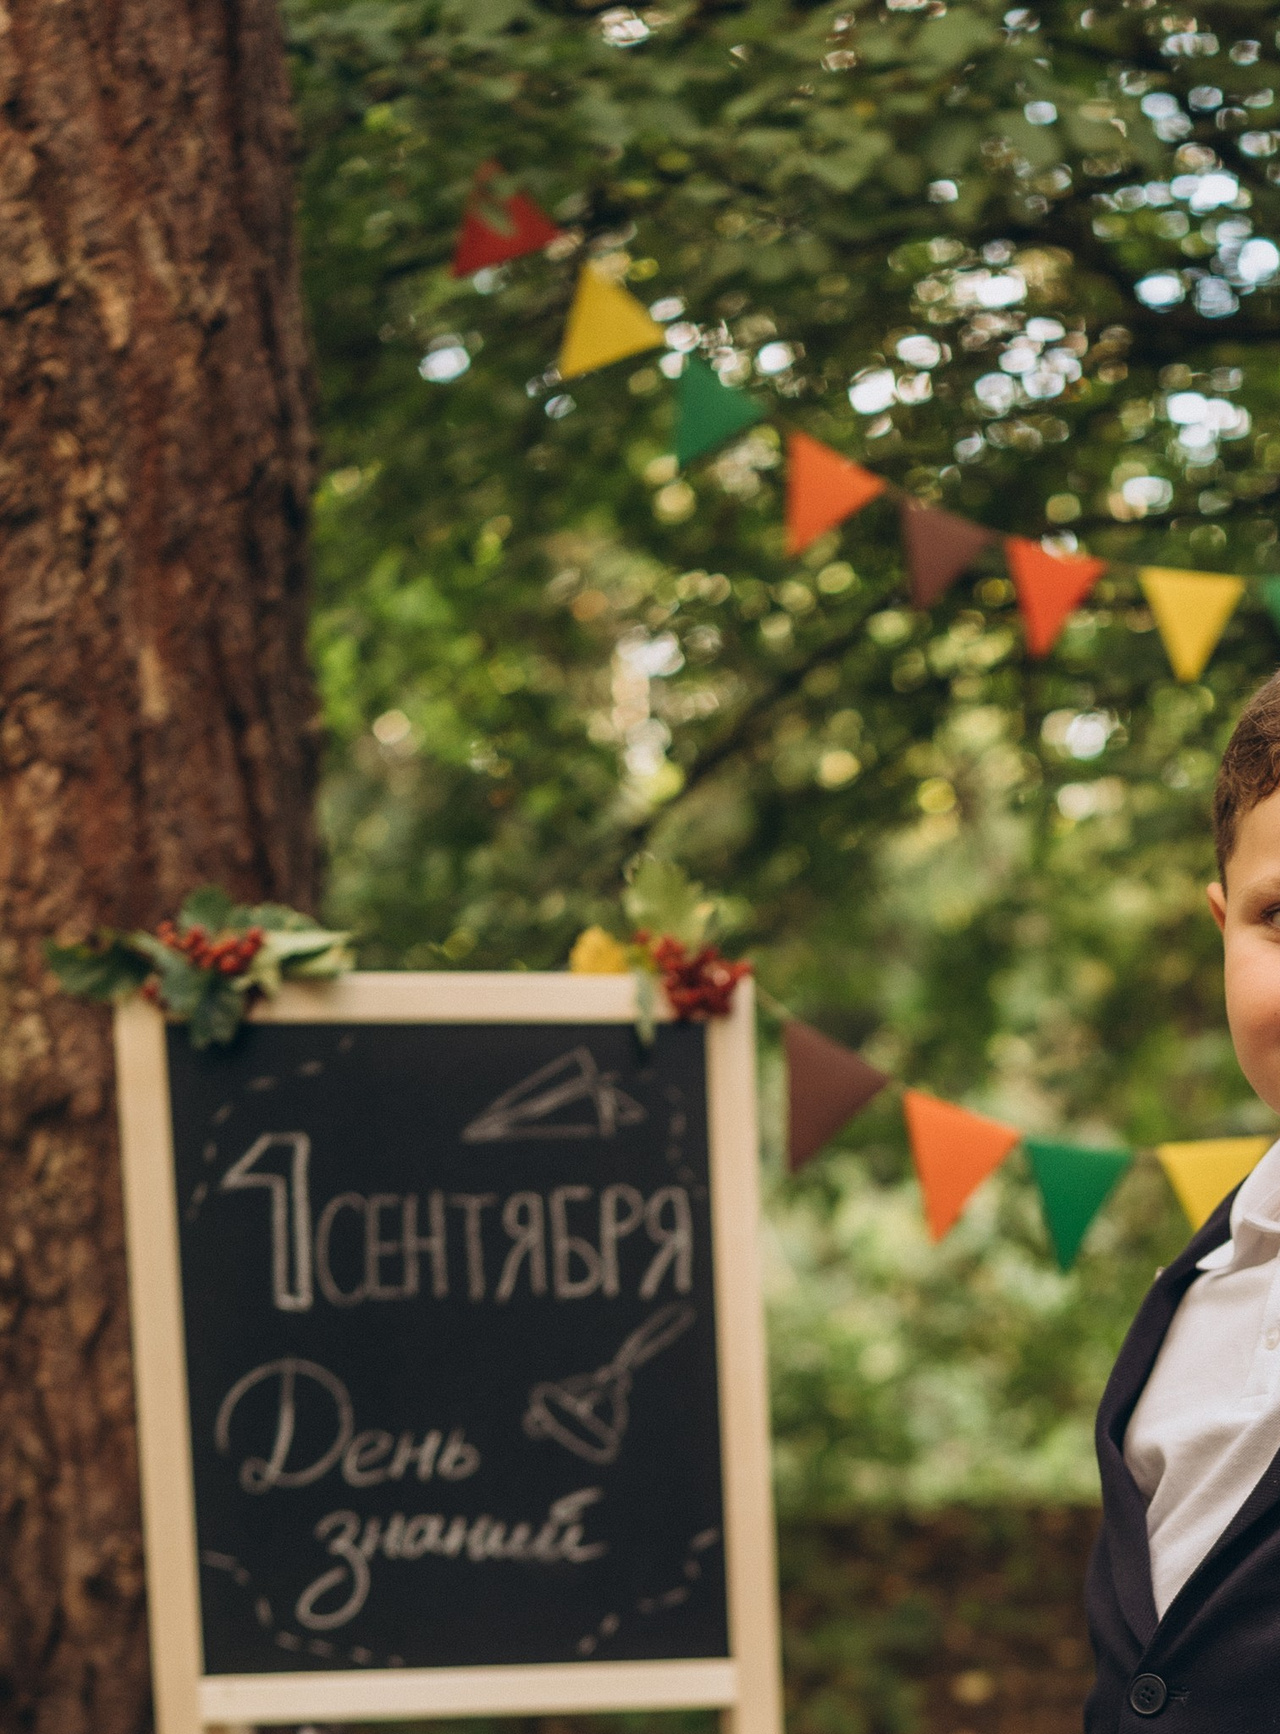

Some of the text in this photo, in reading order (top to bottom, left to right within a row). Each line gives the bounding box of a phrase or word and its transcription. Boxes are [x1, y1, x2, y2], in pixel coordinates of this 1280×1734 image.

[221, 1130, 695, 1312] 1 СЕНТЯБРЯ
[215, 1356, 482, 1495] День
[296, 1486, 606, 1631] знаний
